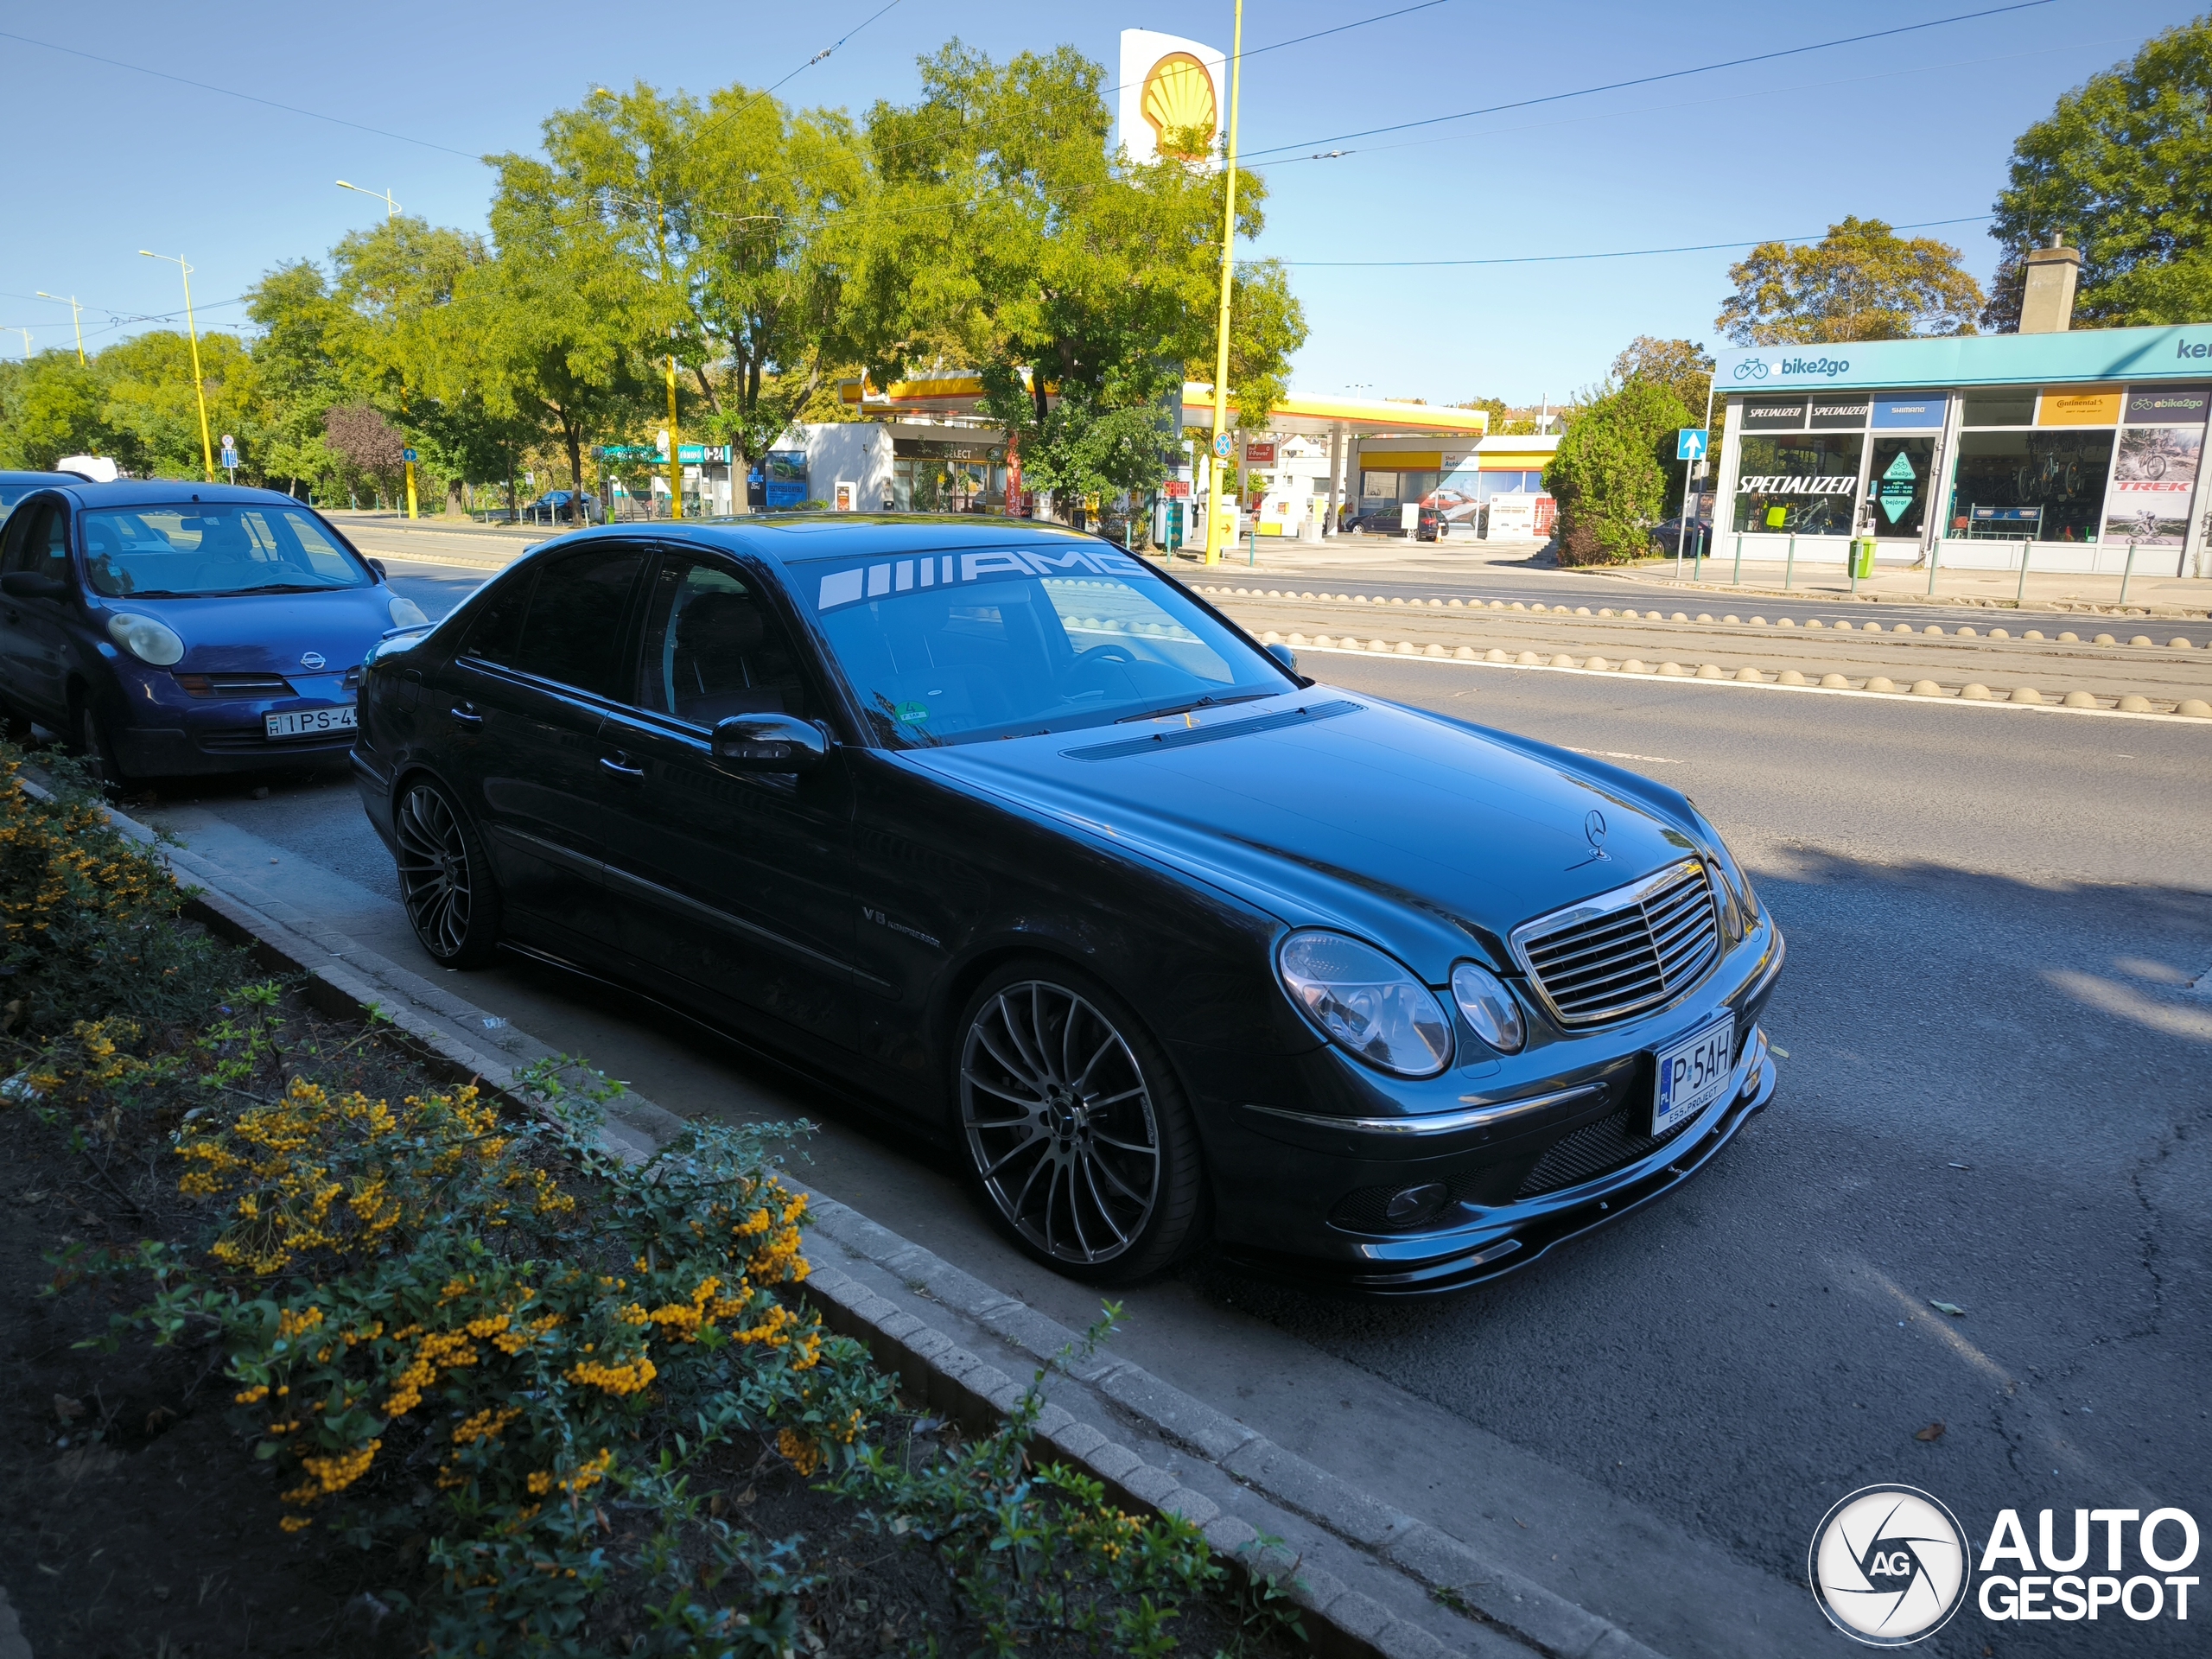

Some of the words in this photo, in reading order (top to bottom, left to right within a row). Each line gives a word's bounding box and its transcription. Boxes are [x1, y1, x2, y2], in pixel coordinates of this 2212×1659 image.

[1770, 358, 1850, 377] ebike2go
[1812, 405, 1868, 416] SPECIALIZED
[2056, 399, 2097, 409] Continental
[2154, 398, 2203, 410] ebike2go
[1748, 407, 1802, 418] SPECIALIZED
[703, 447, 724, 461] 0-24
[1736, 475, 1857, 494] SPECIALIZED
[2117, 482, 2192, 492] TREK
[960, 550, 1157, 582] AMG
[906, 702, 916, 713] 4
[270, 726, 279, 734] H
[862, 906, 887, 925] V8
[887, 920, 940, 948] KOMPRESSOR
[1672, 1058, 1687, 1103] P
[1693, 1030, 1730, 1090] 5AH
[1660, 1092, 1669, 1106] PL
